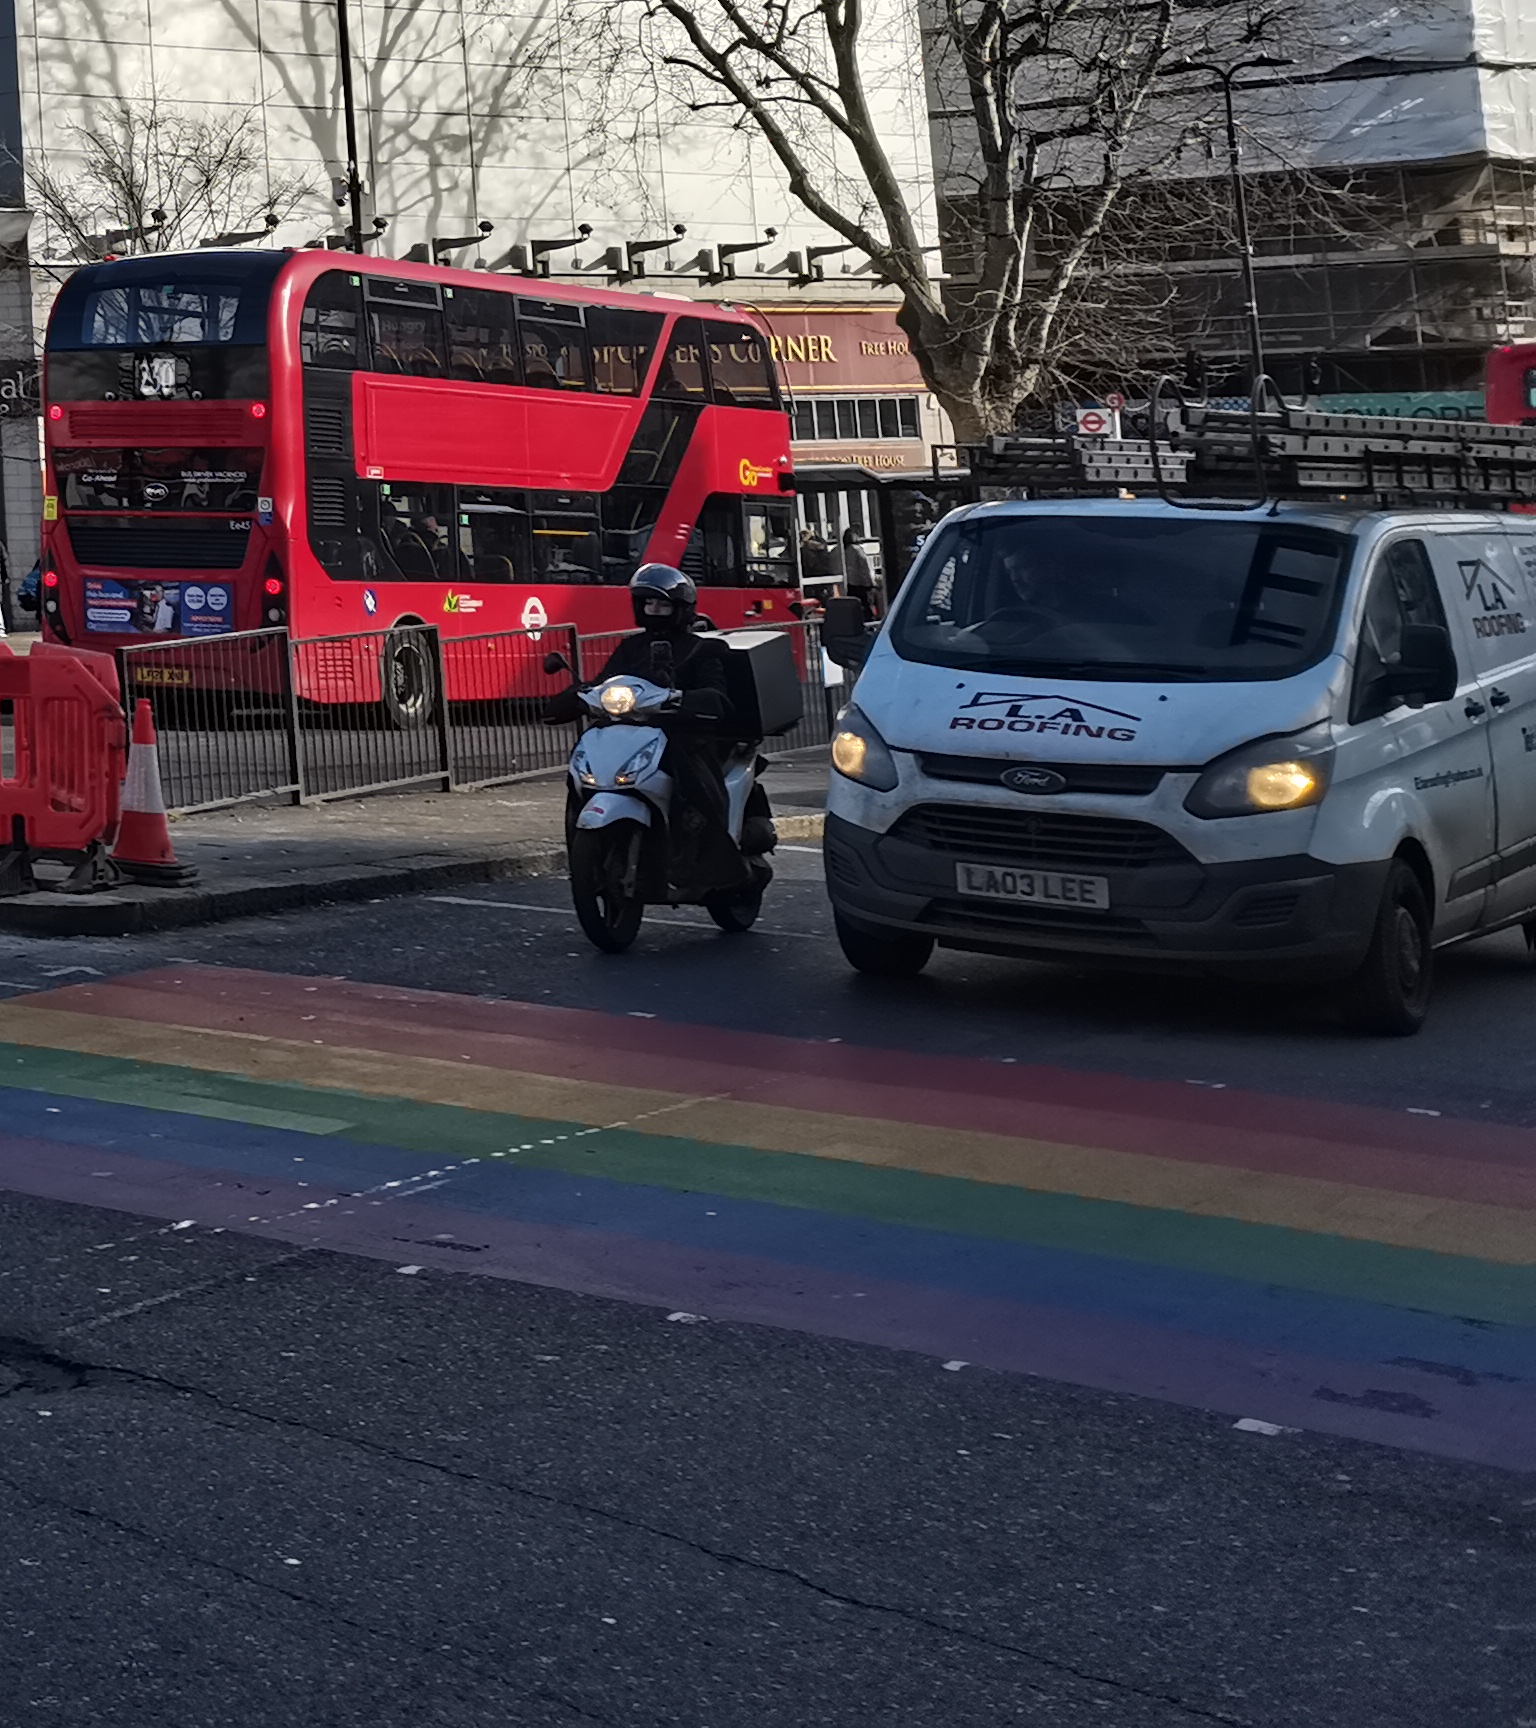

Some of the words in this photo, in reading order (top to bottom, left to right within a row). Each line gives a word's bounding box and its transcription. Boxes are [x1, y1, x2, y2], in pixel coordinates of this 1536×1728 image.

[888, 340, 910, 356] HOU
[1005, 704, 1086, 723] L.A
[949, 717, 1137, 742] ROOFING
[1014, 771, 1051, 787] Ford
[966, 867, 1036, 897] LA03
[1044, 875, 1097, 904] LEE
